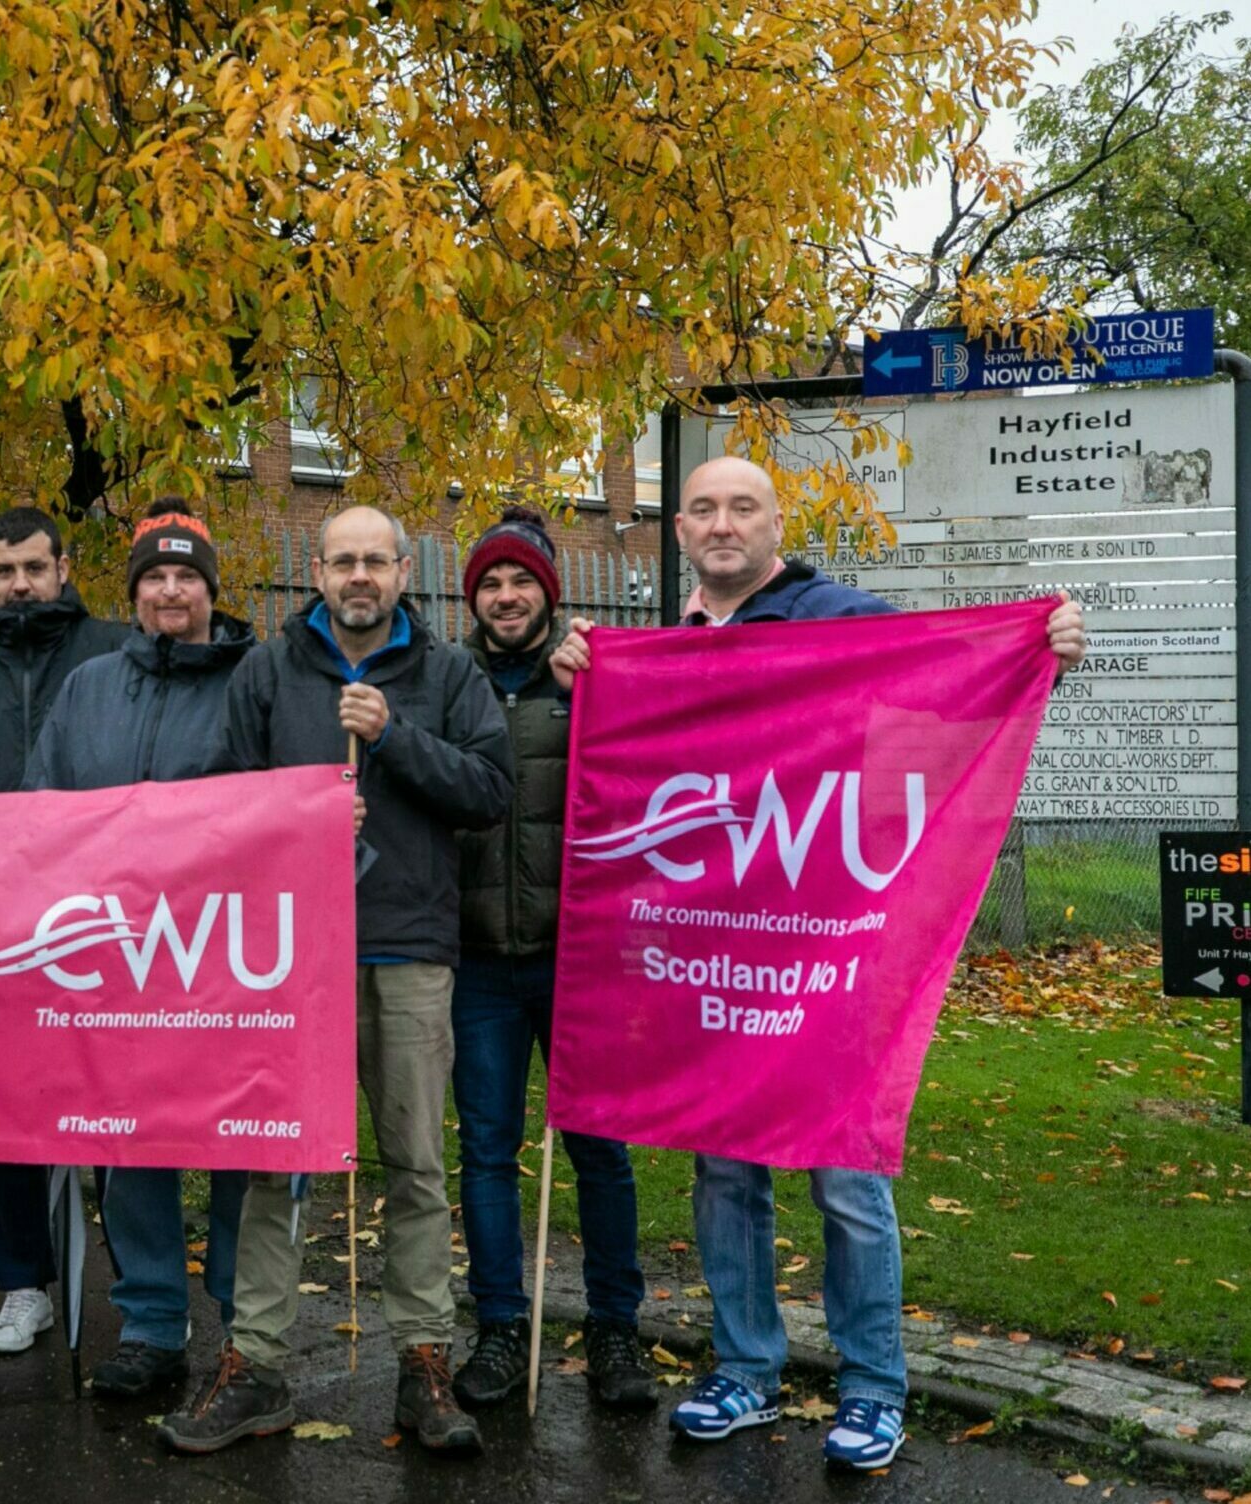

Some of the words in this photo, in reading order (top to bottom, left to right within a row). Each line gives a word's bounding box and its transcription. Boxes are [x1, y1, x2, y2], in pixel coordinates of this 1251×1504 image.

[1057, 317, 1185, 346] OUTIQUE
[1130, 341, 1184, 355] CENTRE
[983, 367, 1033, 386] NOW
[1037, 363, 1096, 382] OPEN
[999, 408, 1132, 437] Hayfield
[990, 439, 1142, 465] Industrial
[862, 465, 897, 484] Plan
[1016, 475, 1116, 494] Estate
[902, 550, 927, 565] LTD.
[942, 547, 955, 562] 15
[960, 546, 1002, 561] JAMES
[1008, 543, 1075, 559] MCINTYRE
[1081, 543, 1090, 557] &
[1096, 542, 1125, 556] SON
[1130, 540, 1158, 556] LTD.
[685, 578, 693, 592] 3
[942, 570, 955, 585] 16
[942, 593, 961, 608] 17a
[965, 592, 991, 608] BOB
[1109, 587, 1139, 604] LTD.
[1086, 637, 1158, 648] Automation
[1162, 635, 1220, 646] Scotland
[1050, 705, 1071, 721] CO
[1116, 729, 1163, 744] TIMBER
[1029, 753, 1058, 768] NAL
[1060, 752, 1178, 769] COUNCIL-WORKS
[1181, 753, 1218, 769] DEPT.
[1034, 776, 1048, 791] G.
[1051, 776, 1100, 792] GRANT
[1103, 777, 1113, 791] &
[1116, 776, 1147, 792] SON
[1151, 777, 1181, 793] LTD.
[1015, 800, 1047, 815] WAY
[1050, 800, 1089, 816] TYRES
[1091, 801, 1100, 815] &
[1103, 801, 1190, 816] ACCESSORIES
[1192, 801, 1222, 817] LTD.
[642, 767, 927, 892] CWU
[1185, 888, 1221, 901] FIFE
[629, 898, 662, 923] The
[665, 904, 848, 937] communications
[33, 890, 295, 994] CWU
[1198, 950, 1220, 959] Unit
[1223, 950, 1229, 958] 7
[642, 946, 803, 996] Scotland
[804, 961, 837, 995] No
[844, 956, 860, 993] 1
[36, 1008, 70, 1028] The
[73, 1008, 234, 1029] communications
[236, 1009, 296, 1030] union
[700, 994, 806, 1036] Branch
[57, 1115, 138, 1135] #TheCWU
[217, 1118, 302, 1139] CWU.ORG
